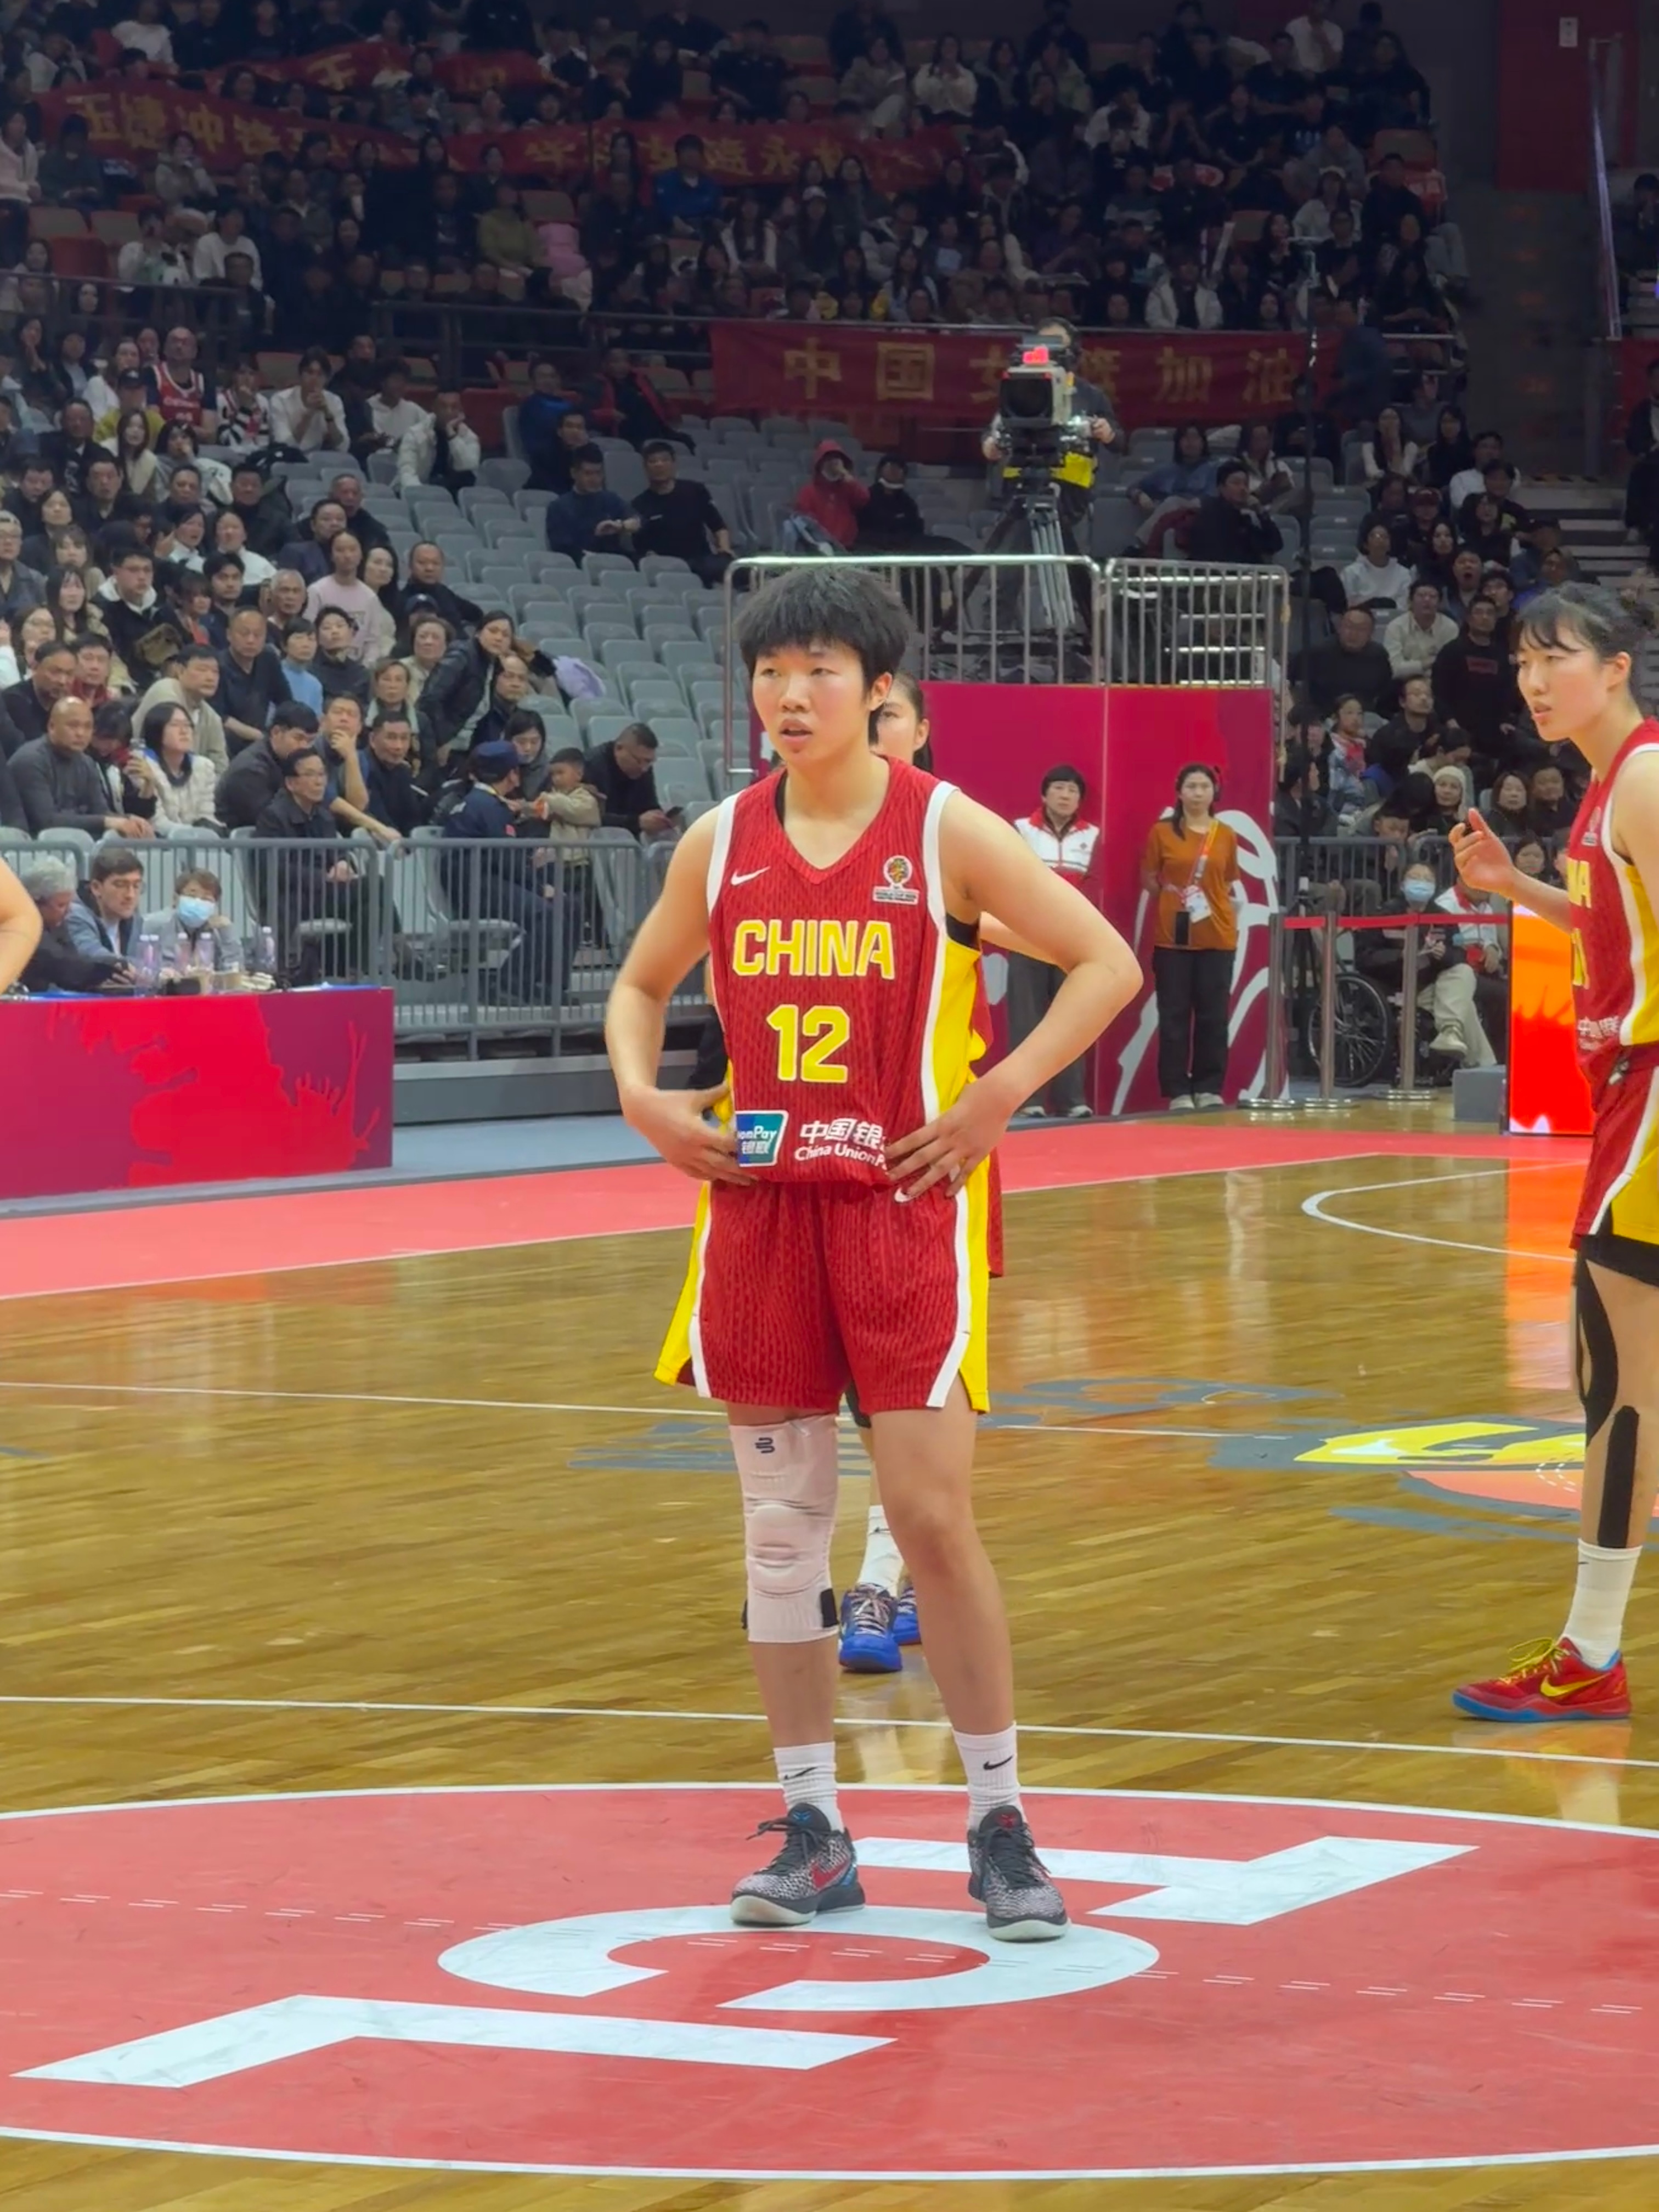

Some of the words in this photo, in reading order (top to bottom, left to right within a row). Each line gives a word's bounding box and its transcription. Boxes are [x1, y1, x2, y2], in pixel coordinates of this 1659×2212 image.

[733, 919, 895, 980] CHINA
[766, 1004, 850, 1083] 12
[794, 1144, 833, 1161] China
[799, 1118, 887, 1152] 中国银
